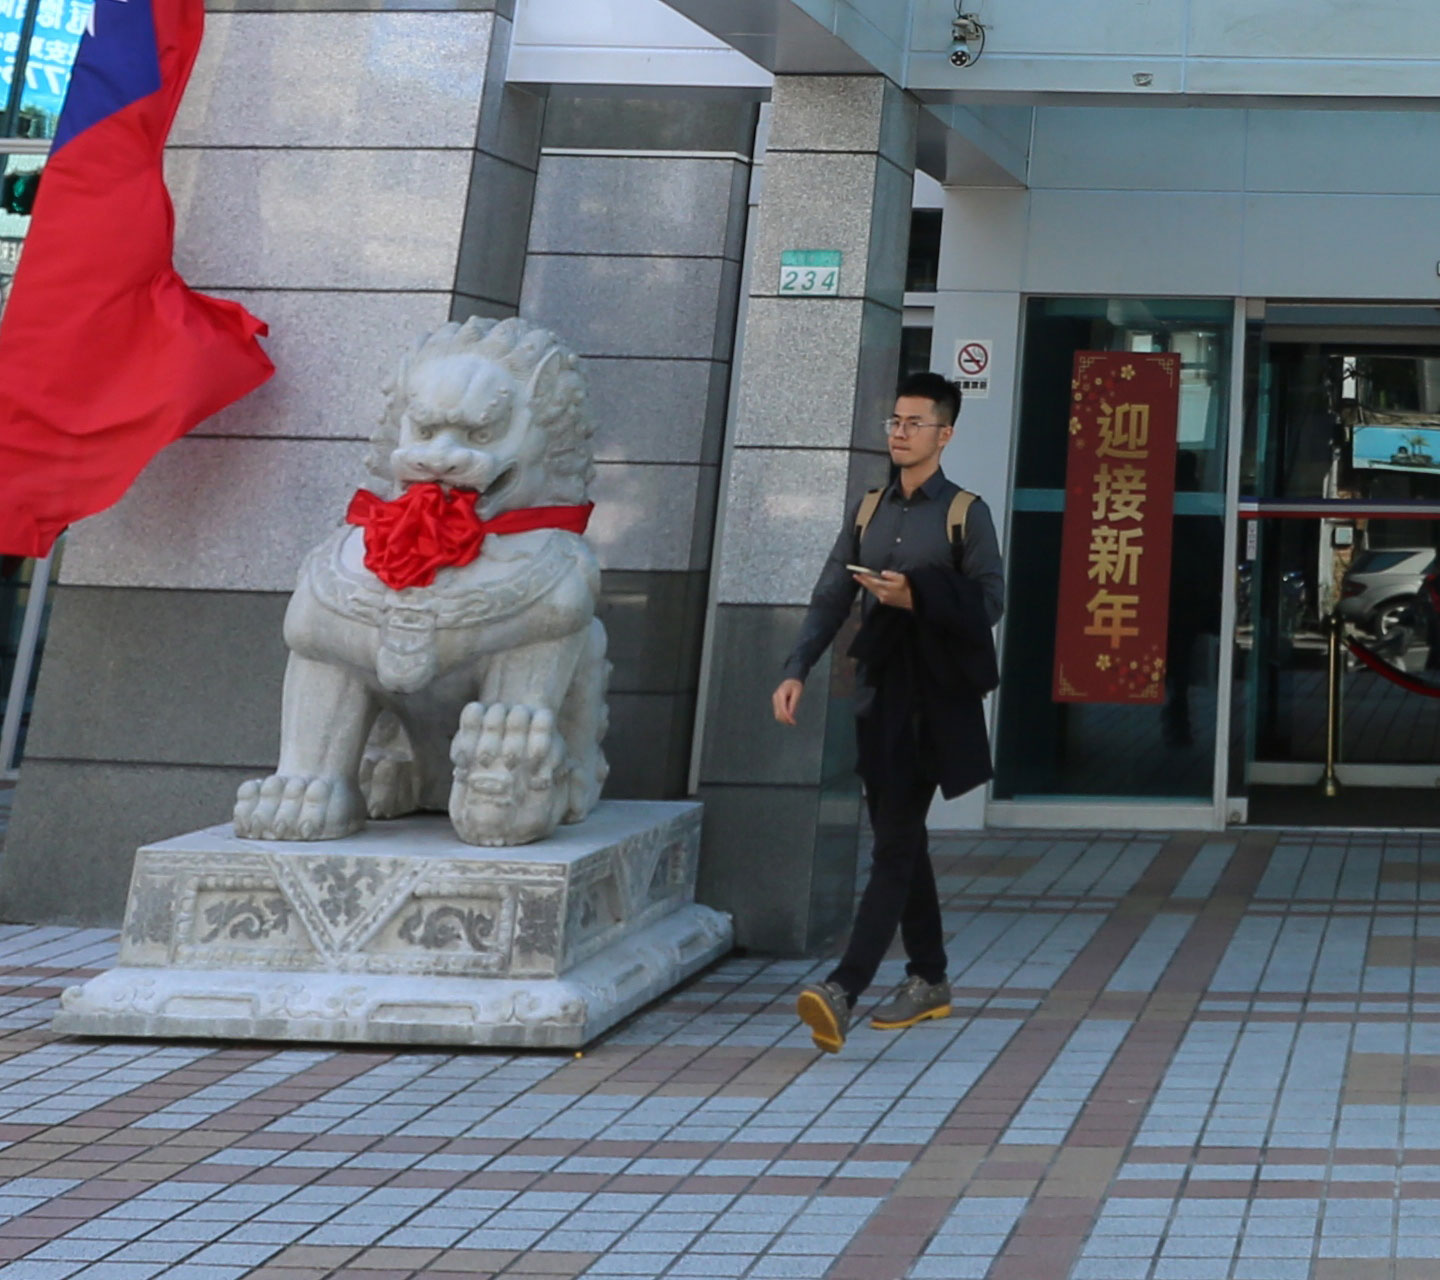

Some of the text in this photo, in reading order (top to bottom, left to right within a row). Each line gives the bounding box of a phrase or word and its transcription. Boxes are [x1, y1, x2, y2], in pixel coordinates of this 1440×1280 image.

[782, 270, 837, 292] 234
[1083, 402, 1151, 649] 迎接新年
